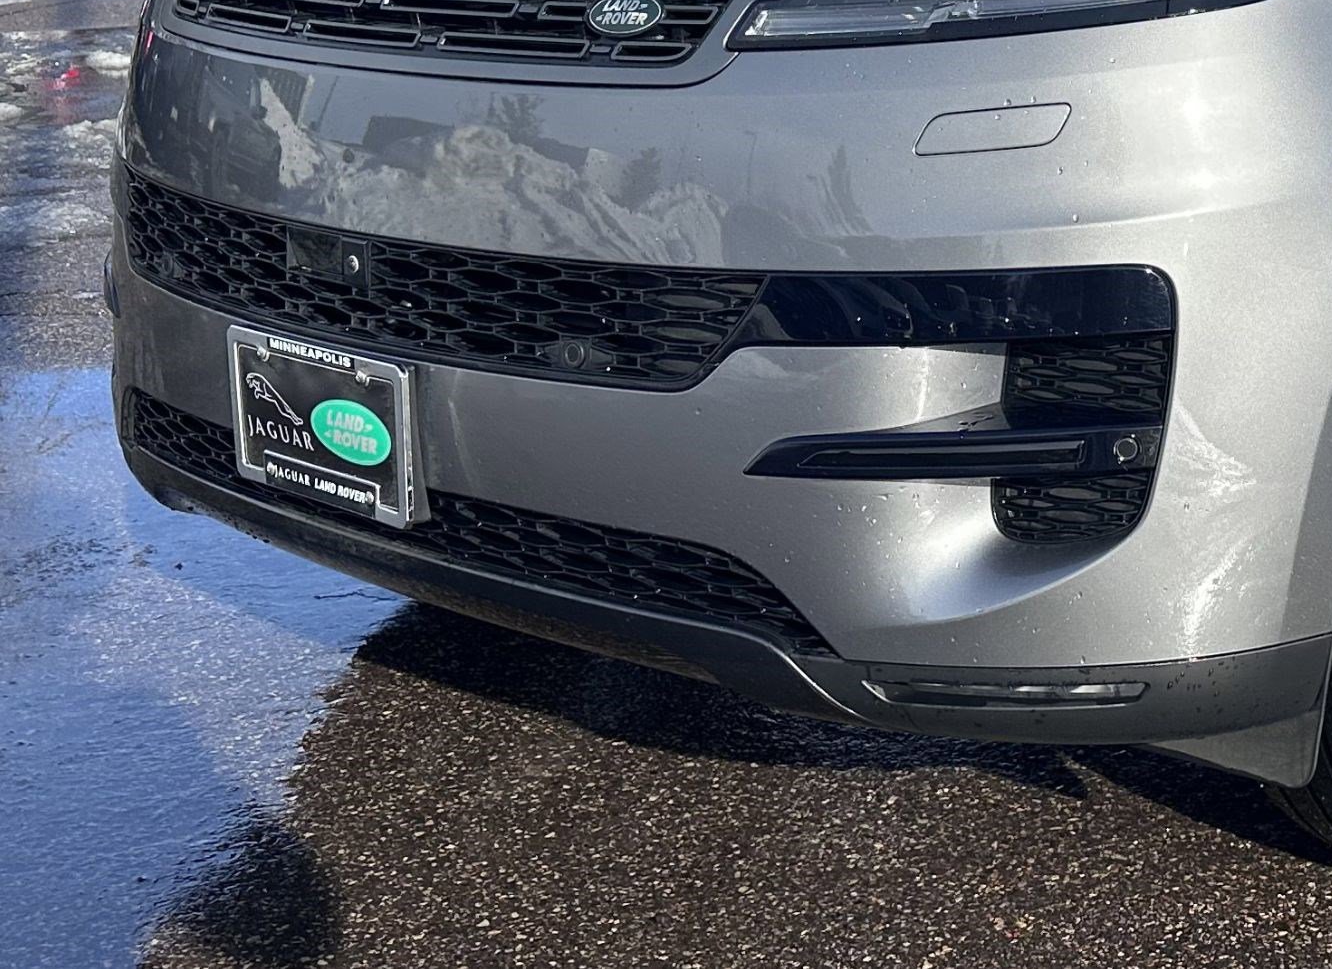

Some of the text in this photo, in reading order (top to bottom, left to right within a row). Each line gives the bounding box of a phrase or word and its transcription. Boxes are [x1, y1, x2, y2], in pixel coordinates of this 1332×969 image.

[269, 338, 351, 367] MINNEAPOLIS
[247, 414, 315, 452] JAGUAR
[274, 466, 366, 503] JAGUAR LAND ROVER
